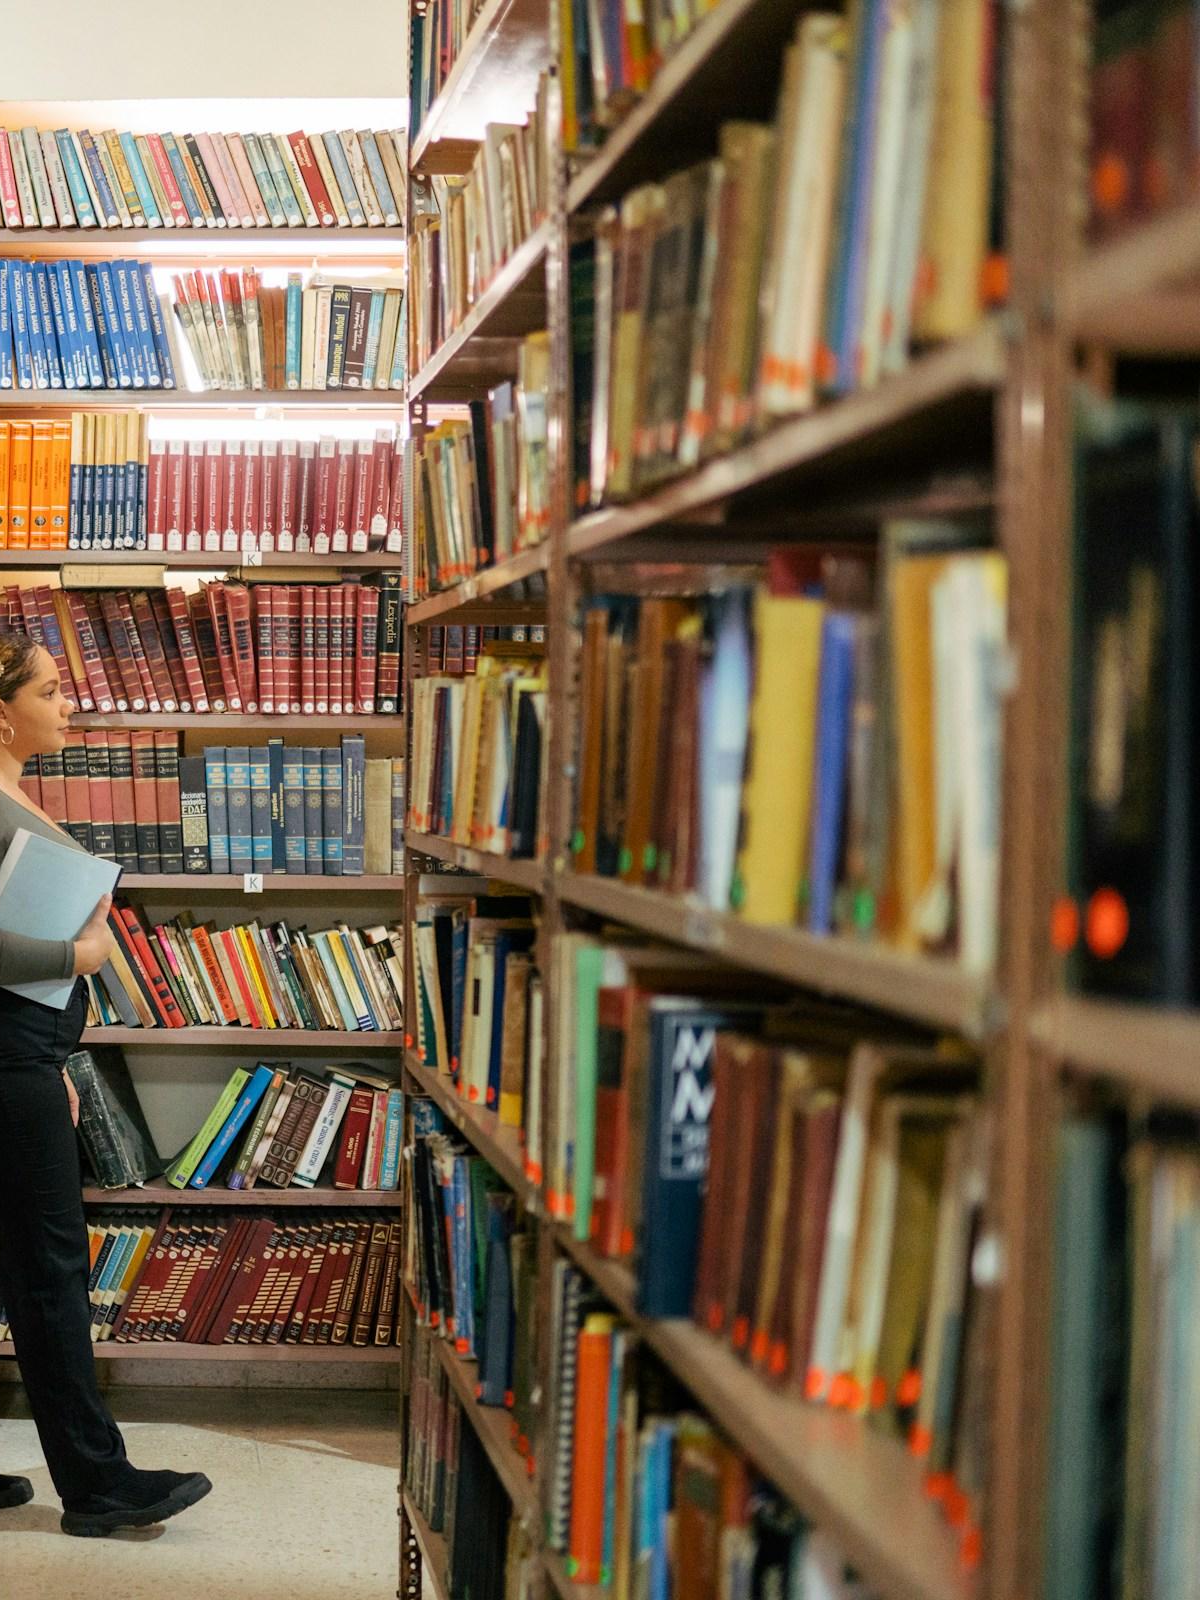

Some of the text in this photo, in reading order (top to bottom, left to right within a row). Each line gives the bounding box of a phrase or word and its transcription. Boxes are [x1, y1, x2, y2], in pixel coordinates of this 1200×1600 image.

[248, 554, 255, 566] K
[385, 600, 398, 644] Lexipedia
[182, 806, 206, 814] EDAF
[250, 878, 258, 888] K
